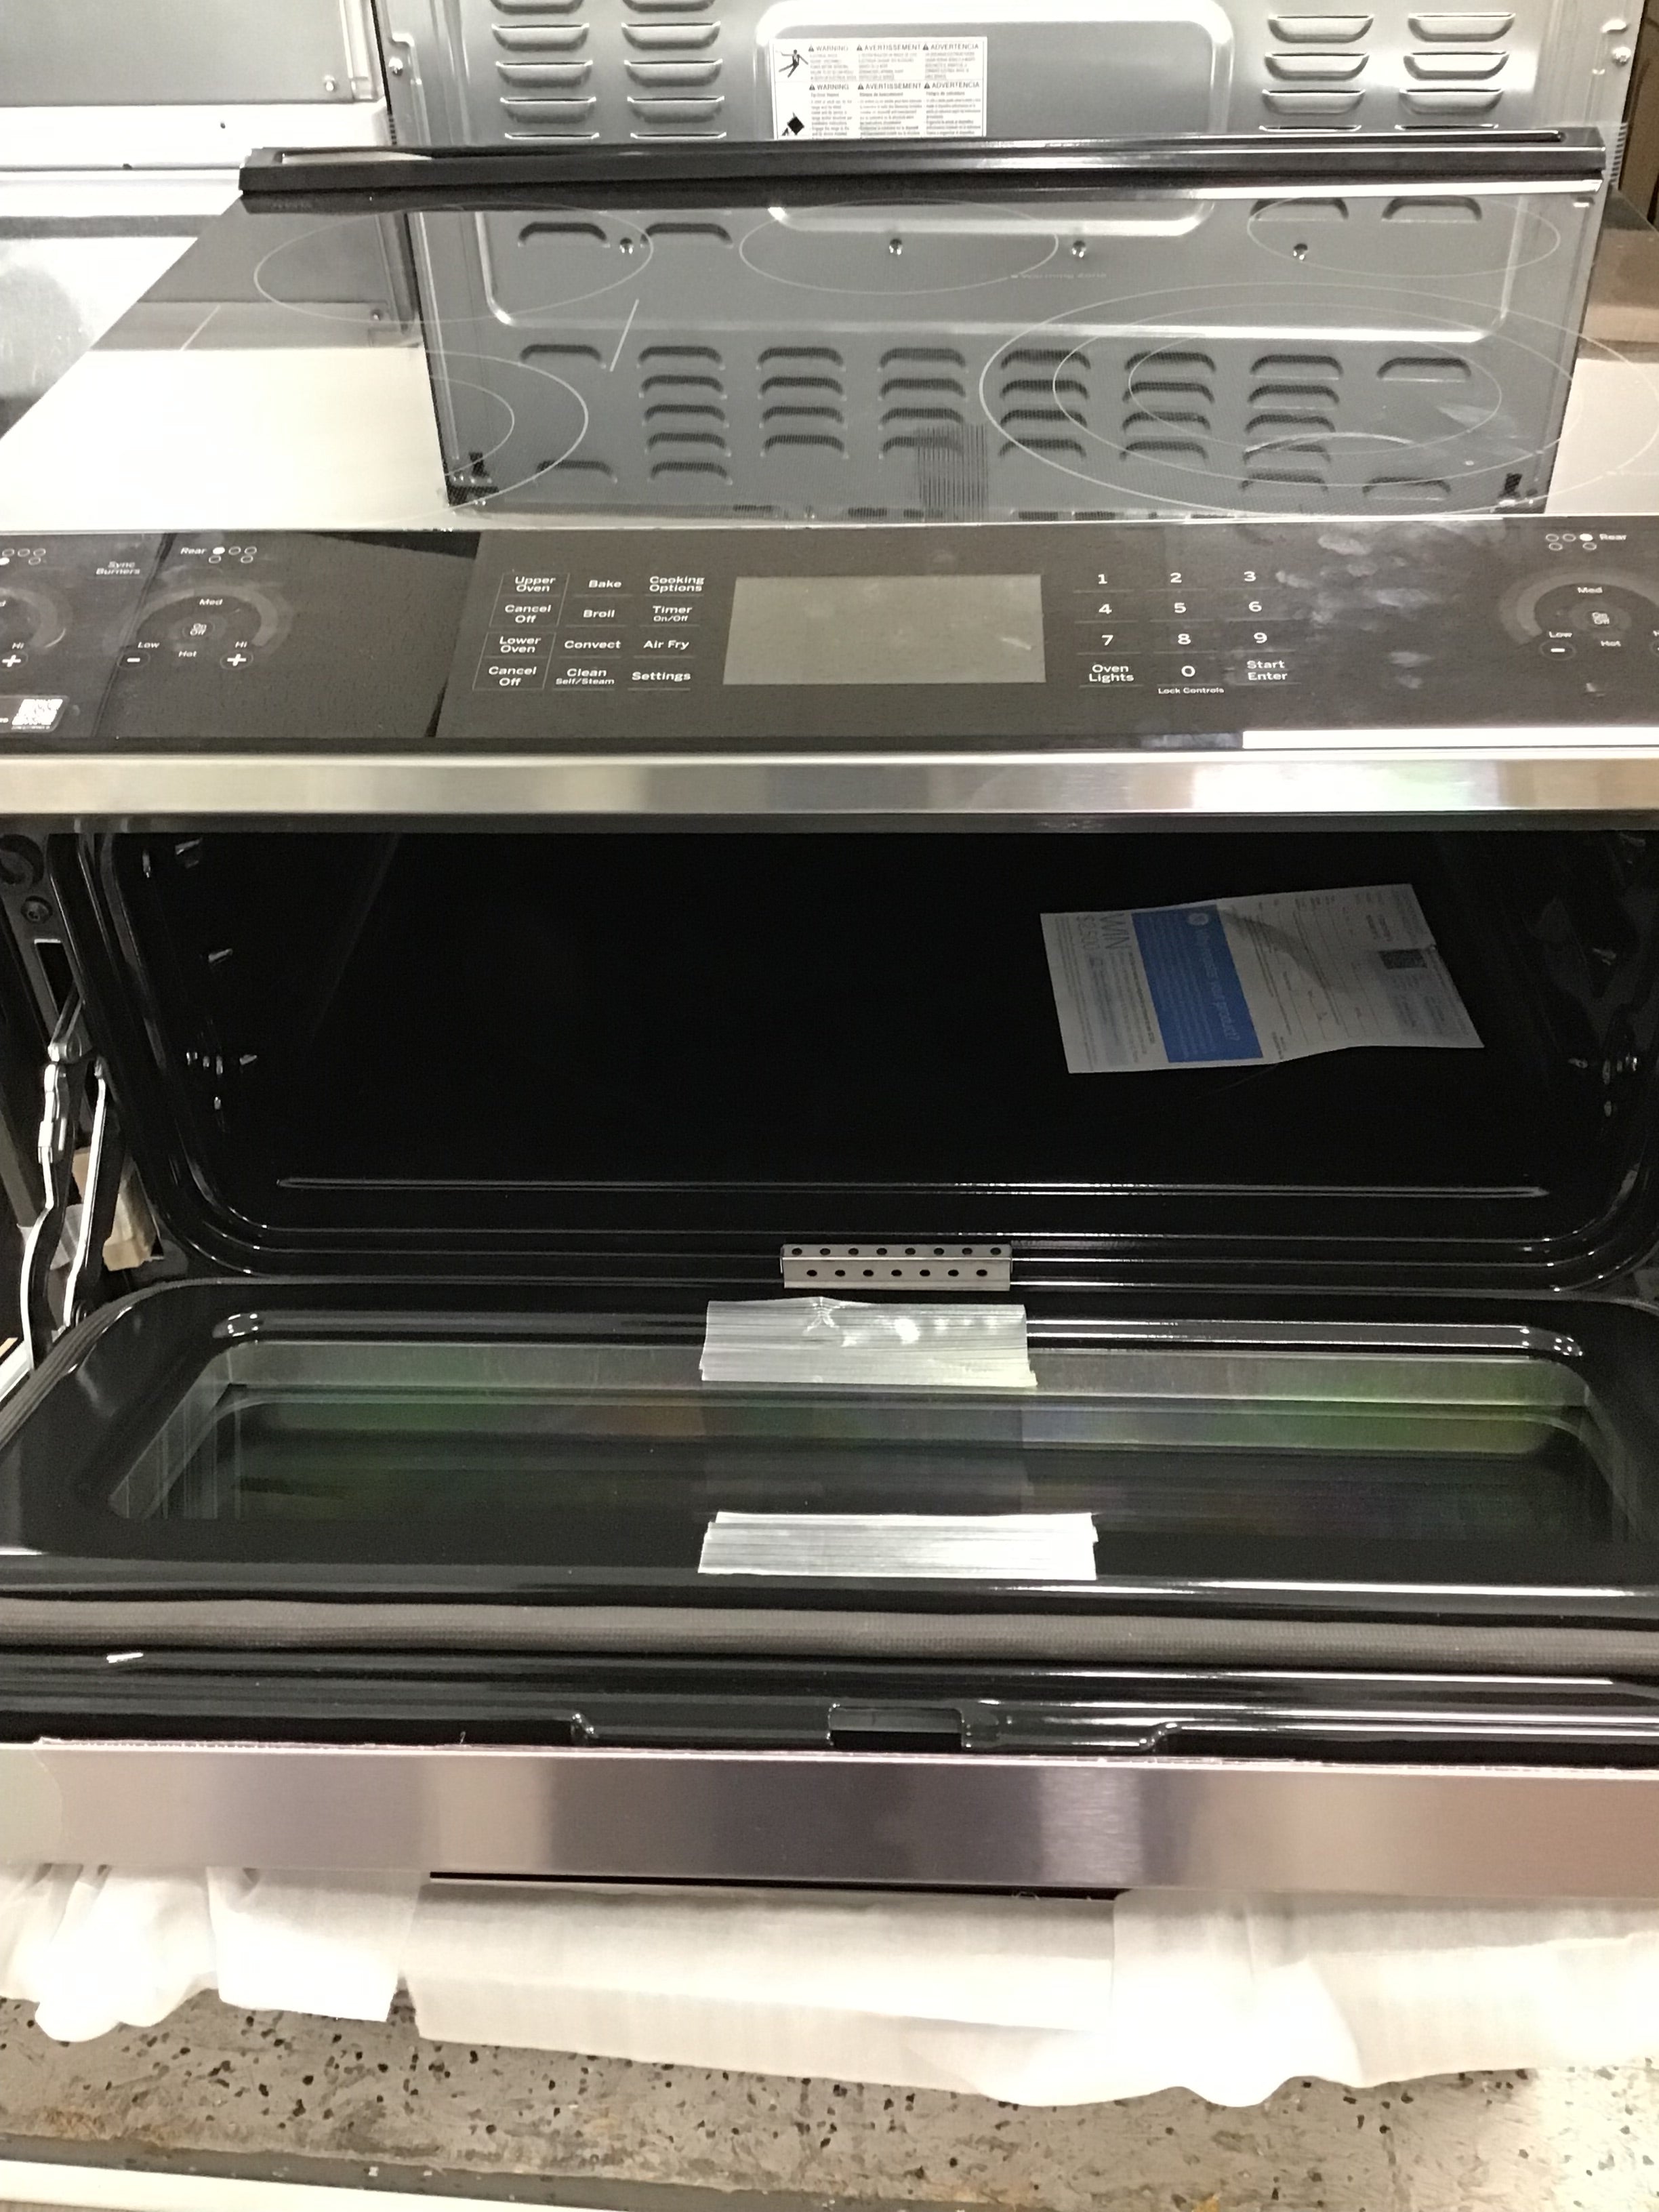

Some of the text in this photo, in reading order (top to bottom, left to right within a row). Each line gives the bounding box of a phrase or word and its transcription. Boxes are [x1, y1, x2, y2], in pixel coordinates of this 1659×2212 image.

[515, 576, 555, 586] Upper
[649, 576, 704, 585] Cooking
[1098, 574, 1107, 584] 1
[1170, 573, 1182, 583] 2
[1244, 571, 1256, 582] 3
[516, 584, 550, 592] Oven
[589, 579, 621, 588] Bake
[649, 584, 702, 593] Options
[505, 605, 551, 613] Cancel
[653, 605, 692, 614] Timer
[1099, 604, 1112, 614] 4
[1174, 602, 1186, 613] 5
[1248, 601, 1262, 612] 6
[583, 610, 615, 618] Broil
[515, 615, 536, 623] Off
[499, 636, 541, 645] Lower
[1102, 635, 1113, 646] 7
[1178, 634, 1191, 644] 8
[1254, 632, 1267, 643] 9
[501, 644, 535, 653] Oven
[564, 640, 621, 649] Convect
[644, 640, 689, 650] Air Fry
[1092, 664, 1128, 672] Oven
[1247, 660, 1285, 669] Start
[489, 666, 537, 675] Cancel
[567, 668, 607, 677] Clean
[632, 672, 691, 682] Settings
[1088, 673, 1134, 683] Lights
[1248, 672, 1287, 680] Enter
[499, 677, 521, 686] Off
[1098, 913, 1132, 949] WIN
